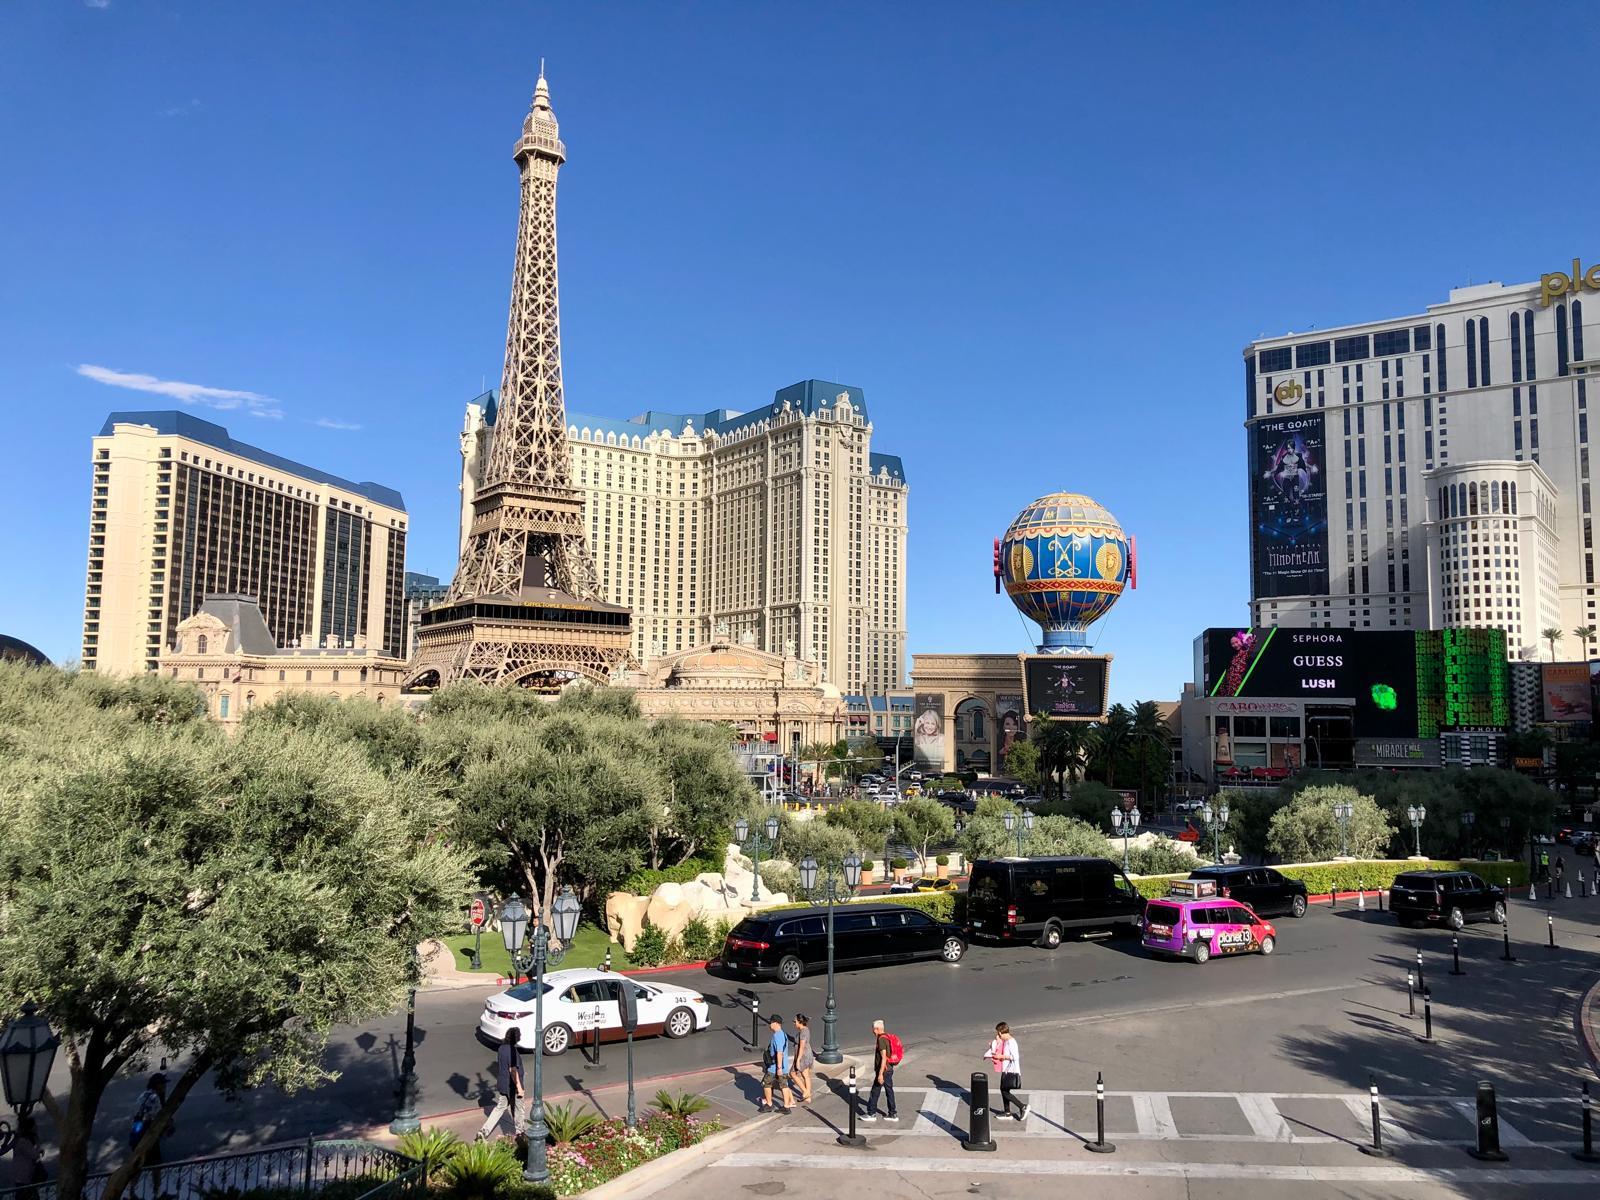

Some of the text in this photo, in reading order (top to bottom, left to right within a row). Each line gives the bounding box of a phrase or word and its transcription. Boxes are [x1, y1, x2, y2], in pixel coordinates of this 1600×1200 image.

[1287, 419, 1321, 429] GOAT!"
[1293, 634, 1343, 643] SEPHORA
[1293, 655, 1343, 667] GUESS
[1301, 679, 1336, 689] LUSH
[1216, 702, 1257, 713] CABO
[1376, 743, 1409, 758] MIRACLE
[1218, 932, 1243, 944] planet
[1242, 928, 1251, 942] 13
[675, 996, 688, 1004] 343
[577, 1011, 606, 1021] Westn
